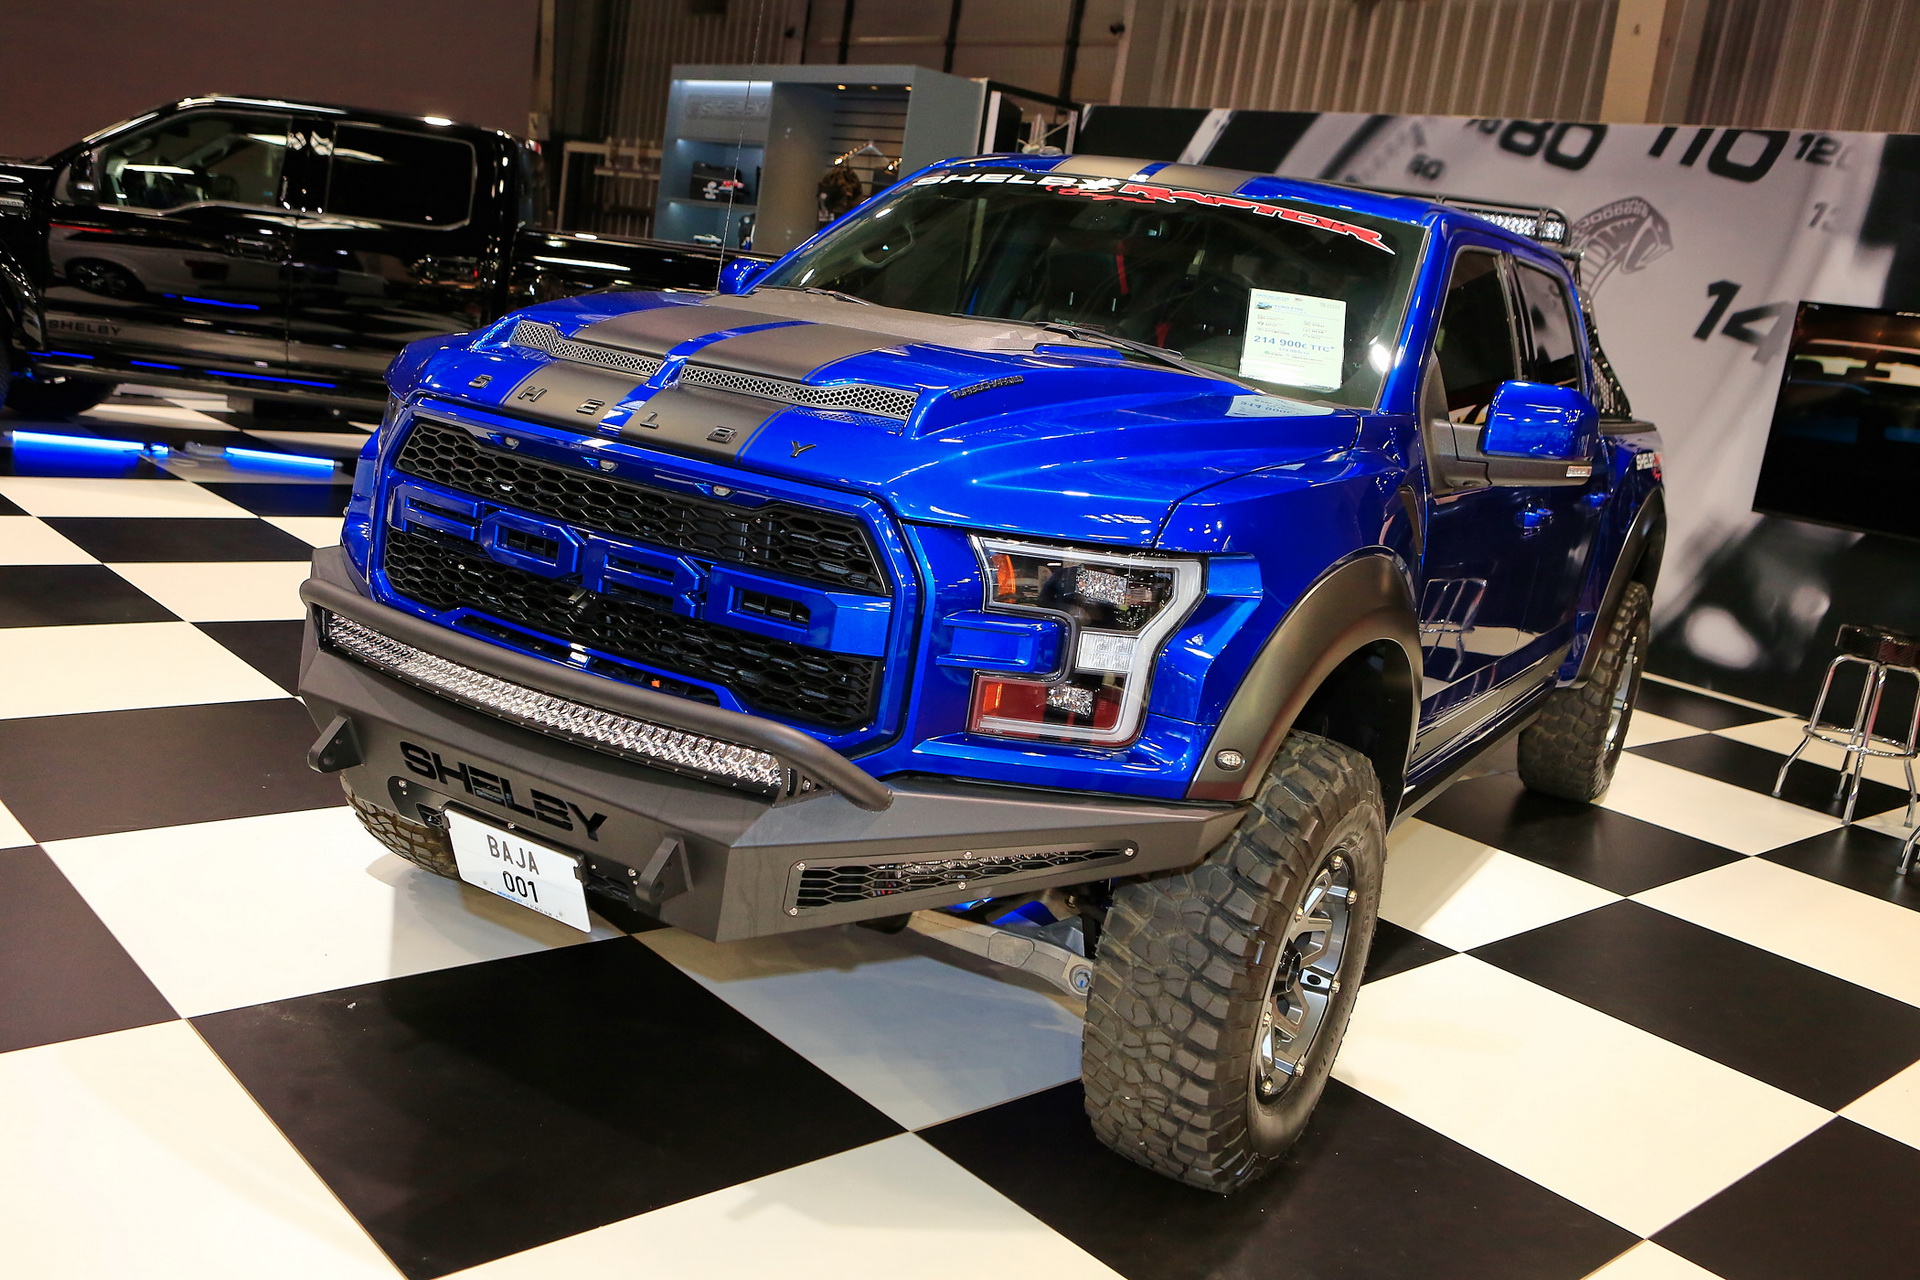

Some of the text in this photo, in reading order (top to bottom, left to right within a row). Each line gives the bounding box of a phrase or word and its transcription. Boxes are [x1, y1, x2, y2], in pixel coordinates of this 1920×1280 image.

[1499, 121, 1608, 171] 80
[911, 173, 1120, 190] SHELBY
[49, 319, 123, 336] SHELBY
[1253, 335, 1276, 345] 214
[468, 374, 817, 458] SHELBY
[386, 483, 840, 656] FORD
[400, 741, 608, 842] SHELBY
[486, 834, 540, 876] BAJA
[502, 870, 539, 904] 001
